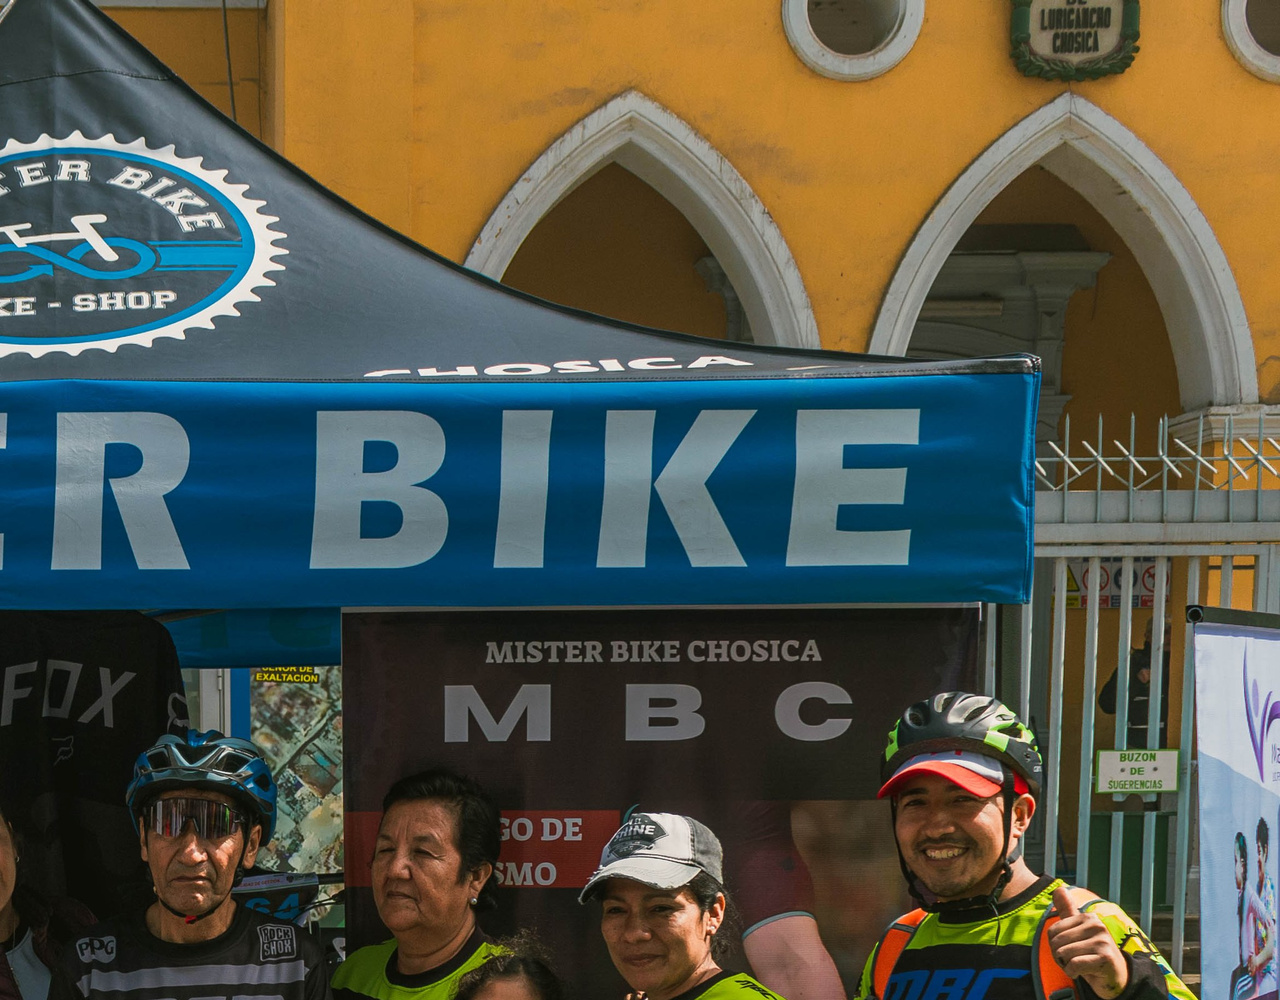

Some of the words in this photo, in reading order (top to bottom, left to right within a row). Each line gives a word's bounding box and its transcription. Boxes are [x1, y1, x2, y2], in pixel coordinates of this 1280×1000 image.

[1040, 7, 1112, 30] LURIGANCHO
[1052, 31, 1100, 53] CHOSICA
[106, 165, 226, 233] BIKE
[72, 290, 178, 313] SHOP
[308, 407, 922, 570] BIKE
[485, 641, 603, 663] MISTER
[610, 641, 681, 662] BIKE
[687, 639, 822, 662] CHOSICA
[256, 672, 318, 683] EXALTACION
[0, 658, 138, 728] FOX
[1119, 752, 1157, 763] BUZON
[1130, 767, 1145, 776] DE
[1107, 779, 1163, 790] SUGERENCIAS
[540, 817, 583, 842] DE
[261, 925, 293, 942] ROCK
[76, 936, 116, 960] PPG
[262, 940, 294, 958] SHOX
